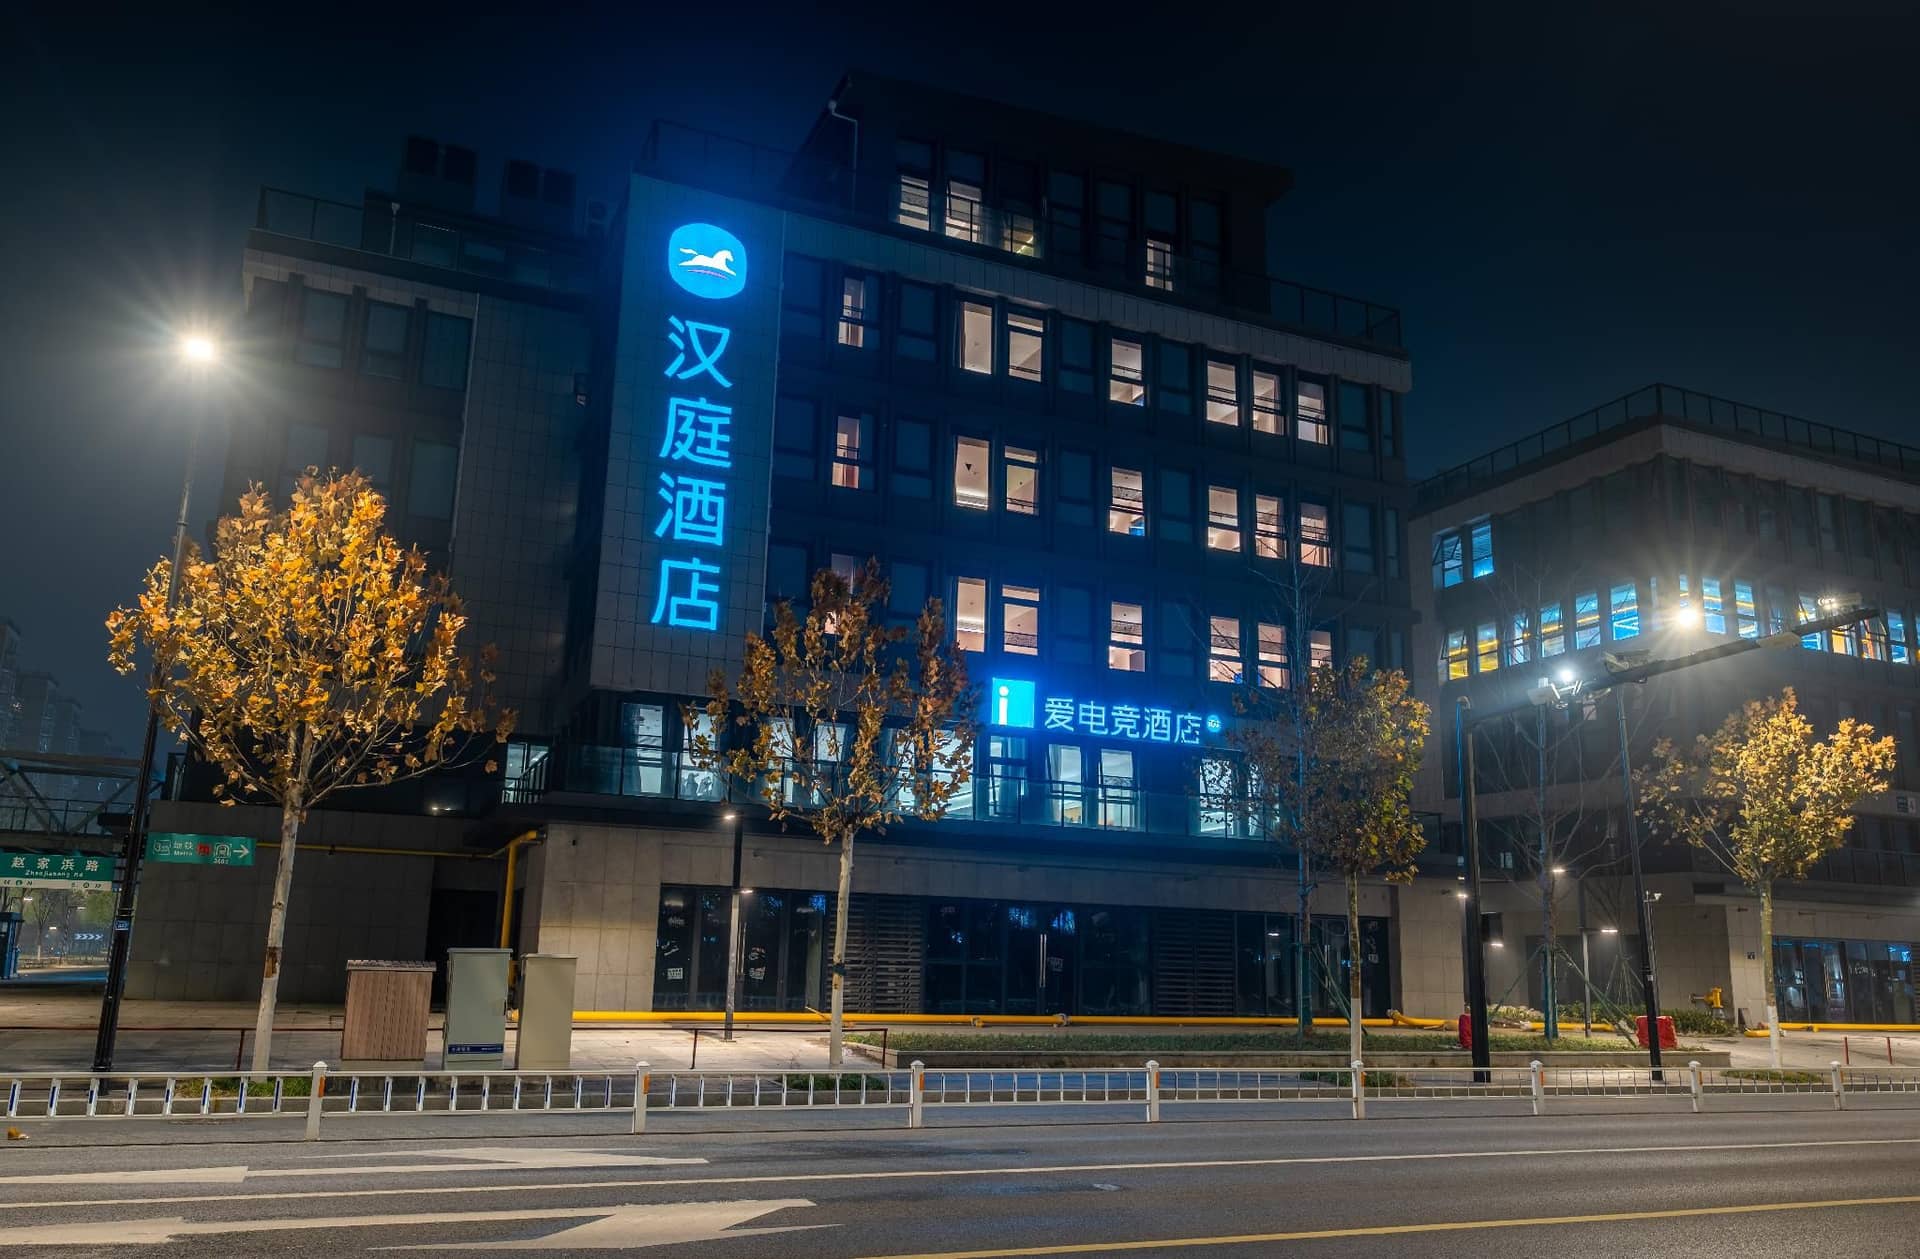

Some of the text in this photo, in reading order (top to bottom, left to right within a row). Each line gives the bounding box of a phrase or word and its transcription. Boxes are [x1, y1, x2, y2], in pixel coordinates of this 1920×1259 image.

[650, 314, 733, 632] 汉庭酒店
[1043, 696, 1203, 745] 爱电竞酒店
[11, 856, 99, 872] 赵家浜路
